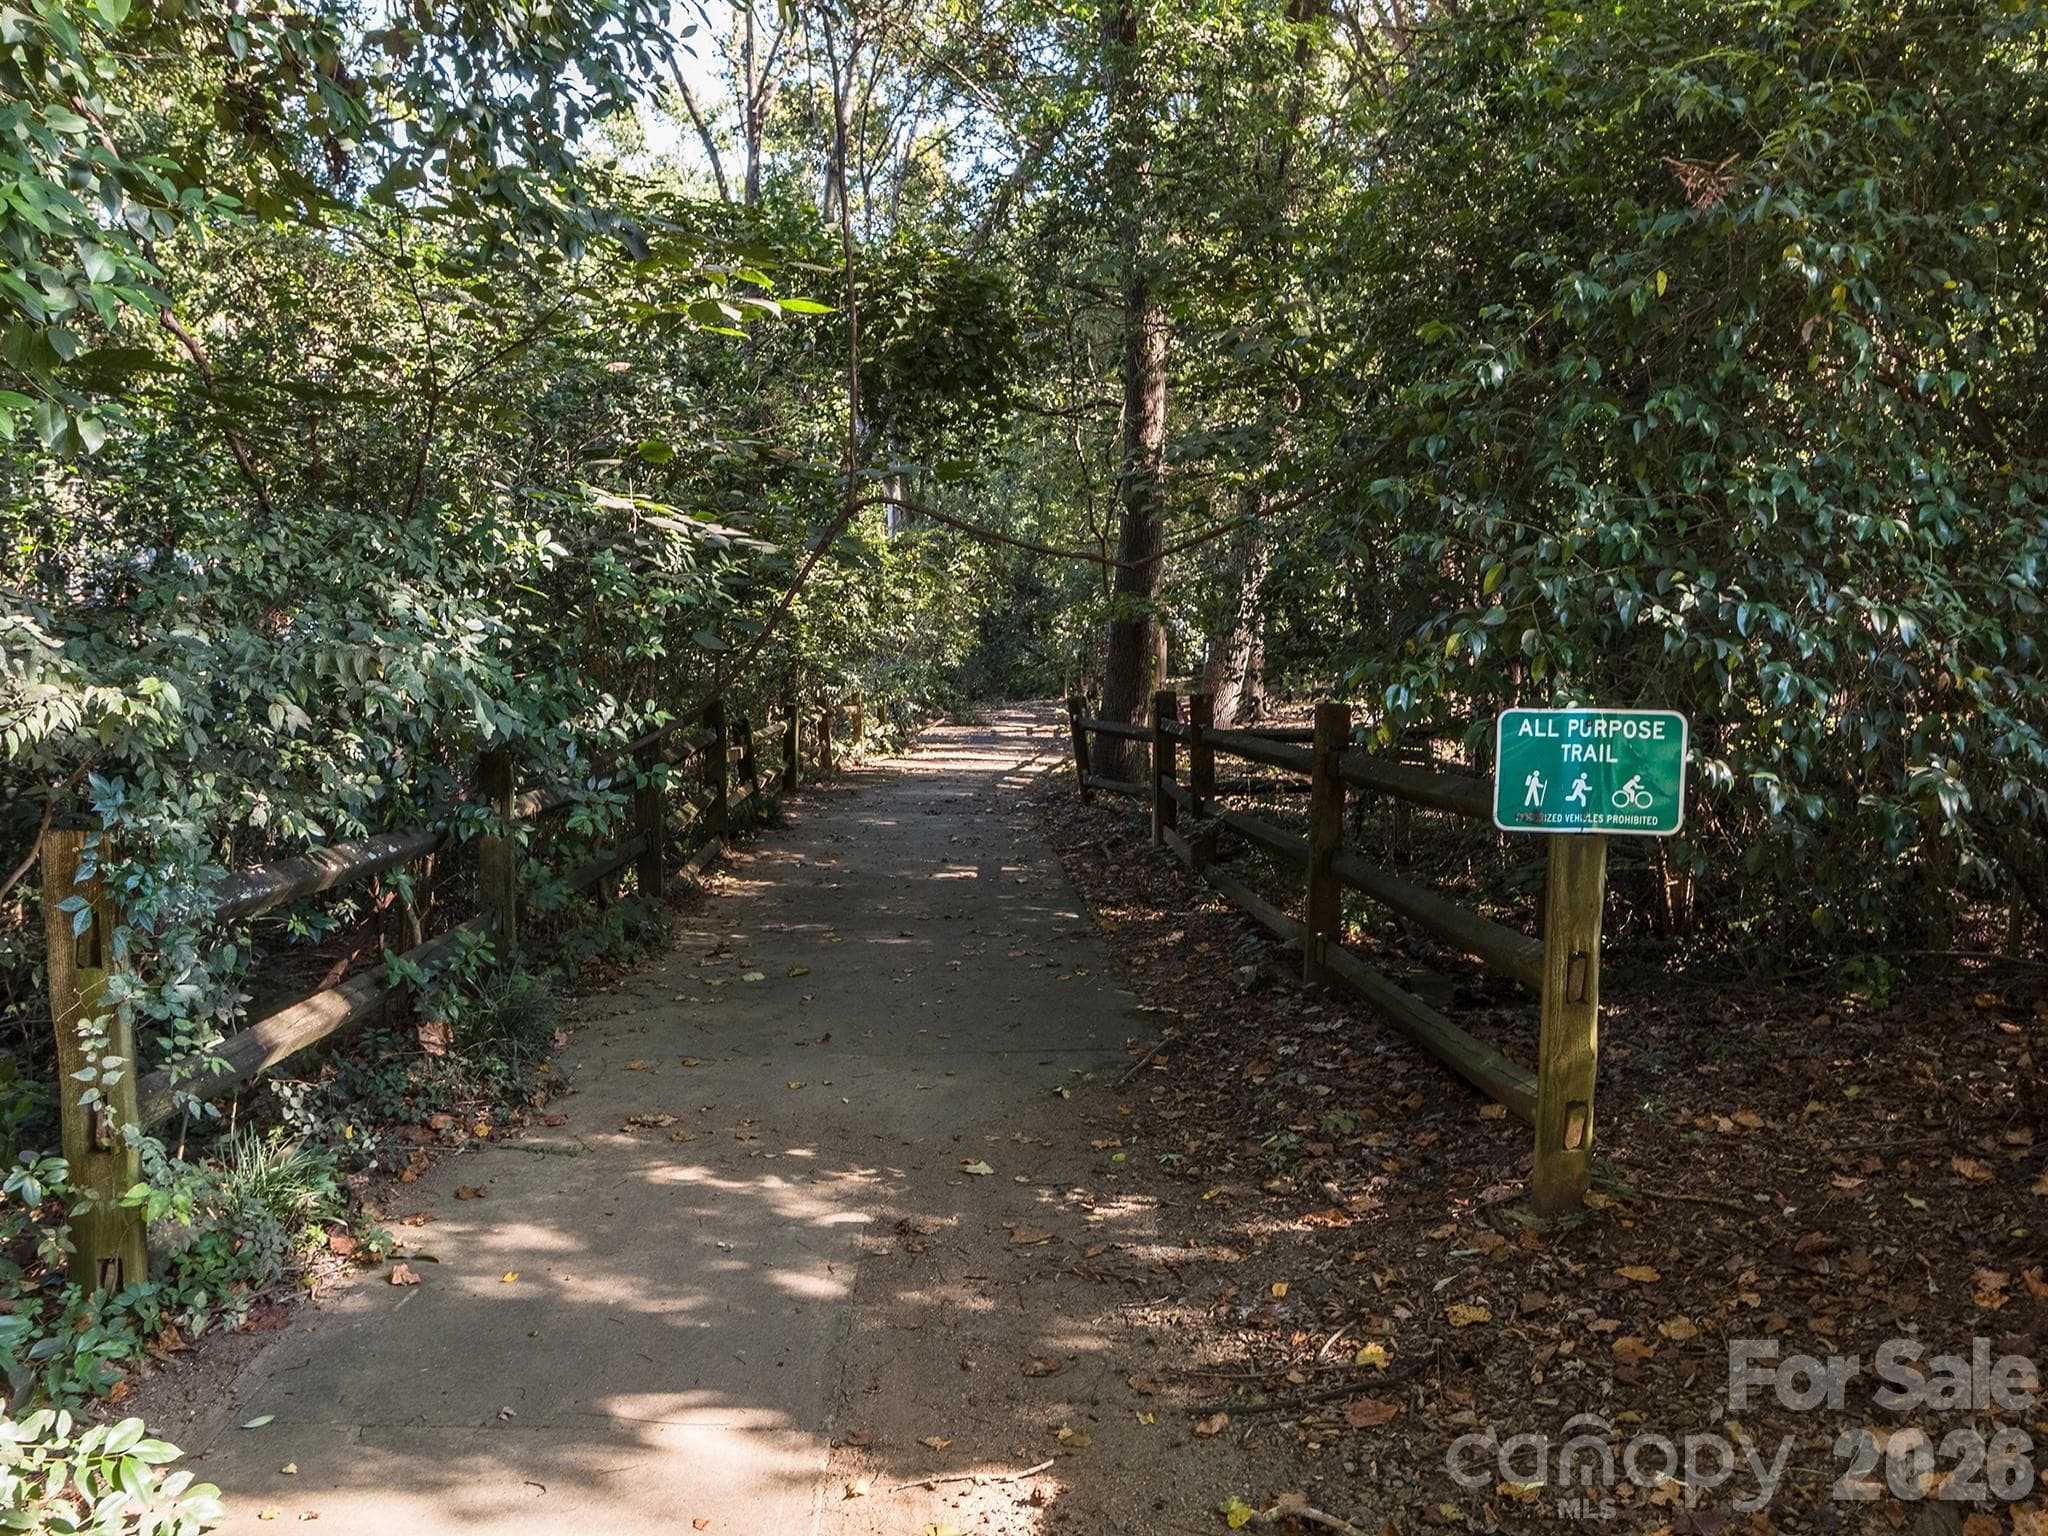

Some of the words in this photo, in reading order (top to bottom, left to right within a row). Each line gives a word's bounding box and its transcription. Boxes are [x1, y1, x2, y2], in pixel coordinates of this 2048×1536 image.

[1518, 719, 1559, 737] ALL
[1567, 719, 1665, 740] PURPOSE
[1561, 744, 1618, 763] TRAIL
[1606, 814, 1658, 826] PROHIBITED
